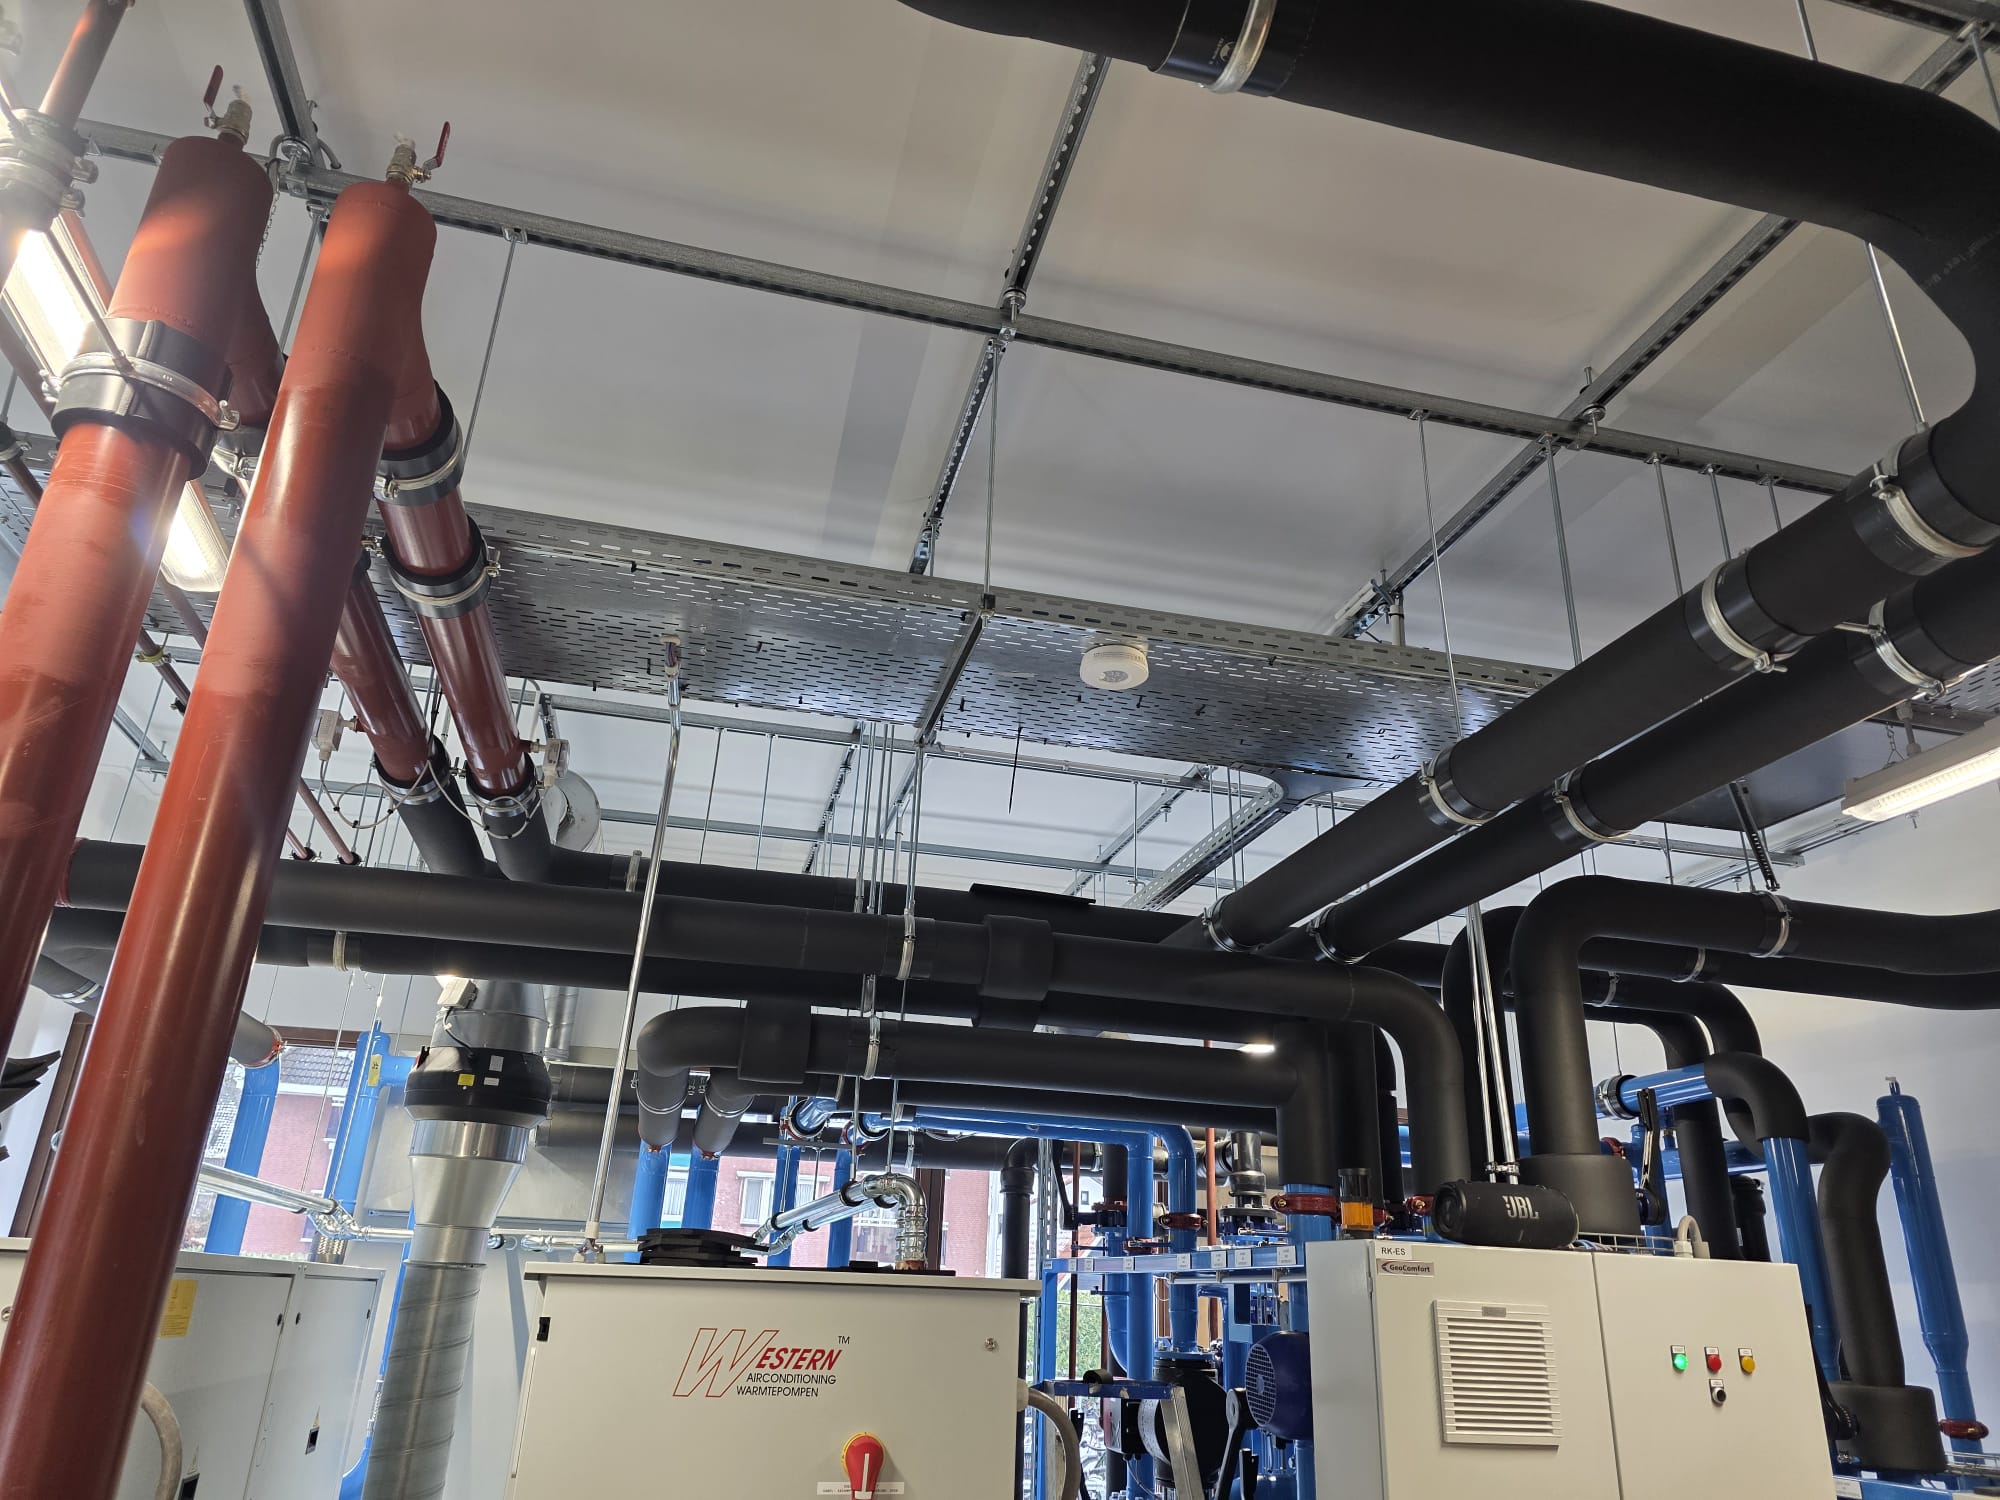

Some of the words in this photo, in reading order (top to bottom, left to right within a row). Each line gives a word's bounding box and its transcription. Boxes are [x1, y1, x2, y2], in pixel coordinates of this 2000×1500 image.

[1502, 1195, 1539, 1219] JBL
[1381, 1246, 1406, 1256] RK-ES
[1389, 1264, 1430, 1273] GeoComfort
[672, 1328, 843, 1398] WESTERN
[838, 1335, 850, 1345] TM
[746, 1372, 837, 1385] AIRCONDITIONING
[736, 1385, 819, 1397] WARMTEPOMPEN
